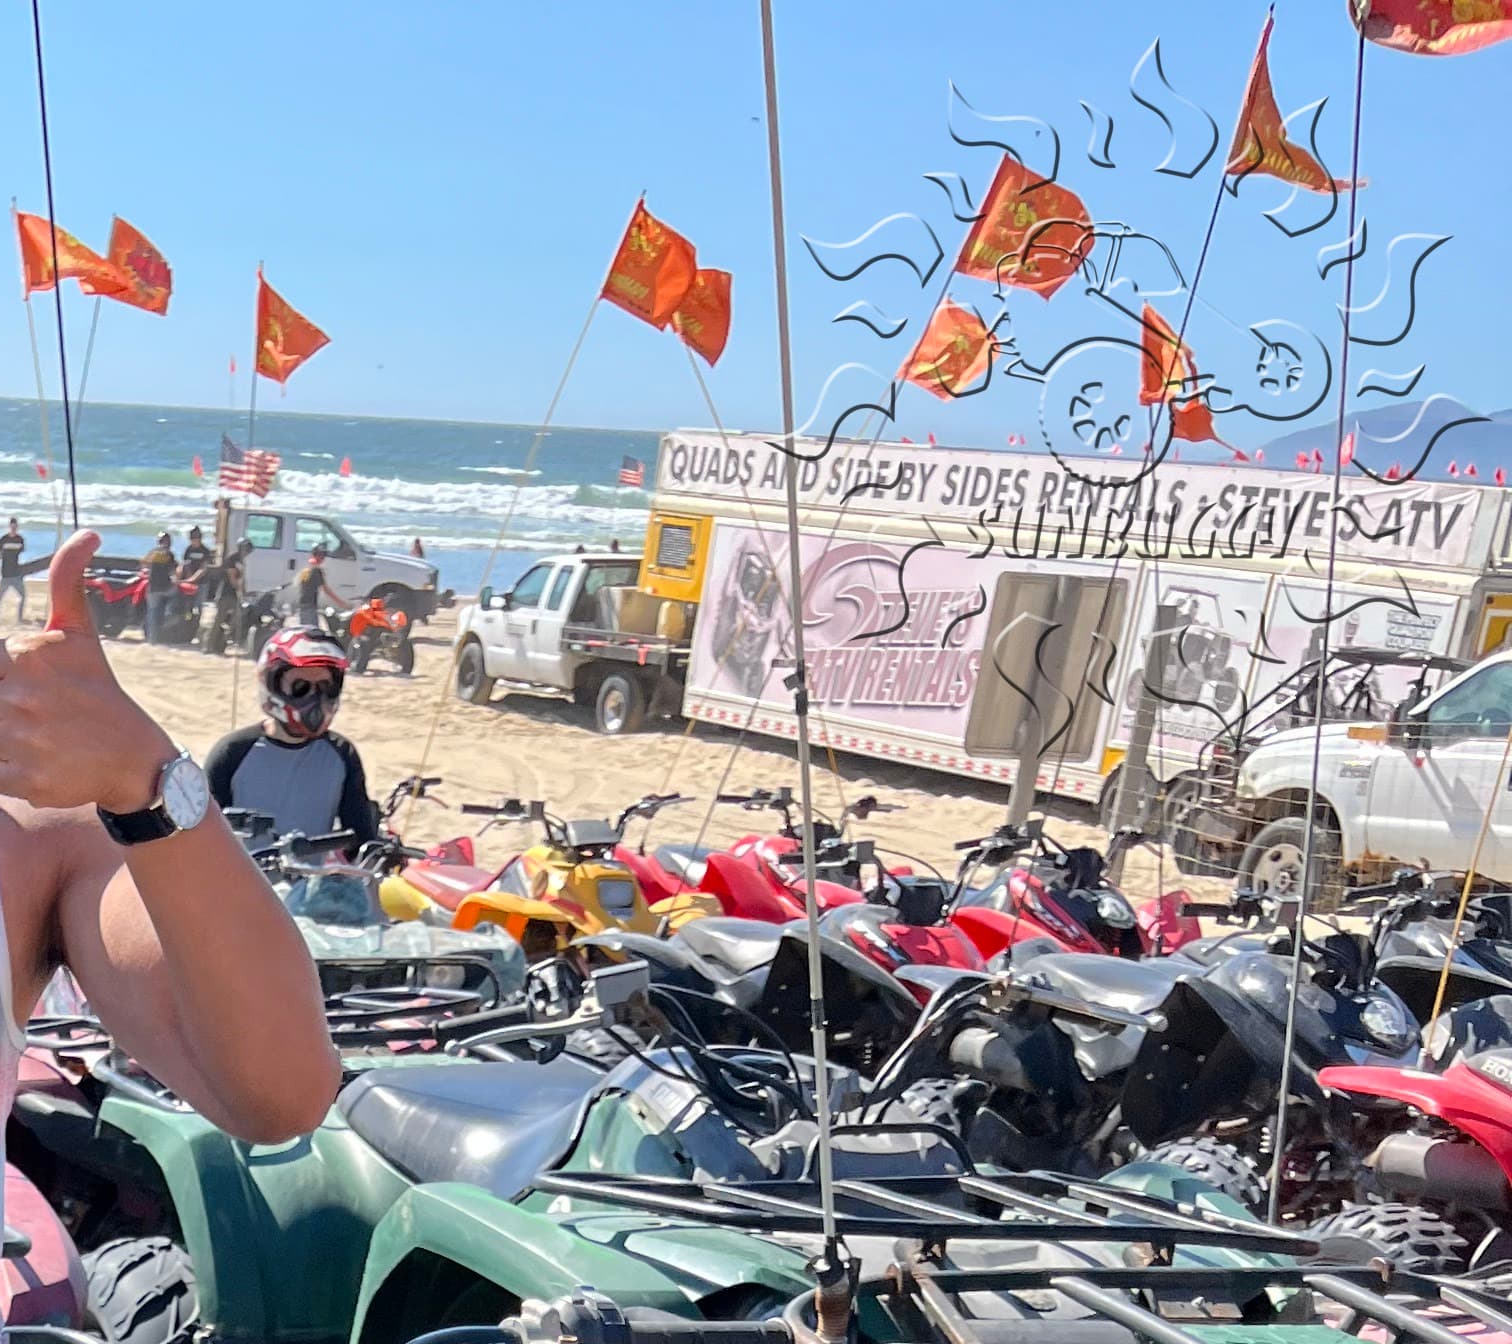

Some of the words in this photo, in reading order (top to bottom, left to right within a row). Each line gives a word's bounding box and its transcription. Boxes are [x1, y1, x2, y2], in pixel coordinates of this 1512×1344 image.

[670, 443, 753, 487] QUADS
[759, 455, 820, 493] AND
[827, 456, 893, 497] SIDE
[895, 461, 937, 503] BY
[940, 464, 1030, 508] SIDES
[1035, 470, 1188, 524] RENTALS
[1212, 482, 1365, 542] STEVE'S
[1370, 498, 1465, 550] ATV
[851, 649, 982, 707] RENTALS
[1480, 1056, 1512, 1085] HO
